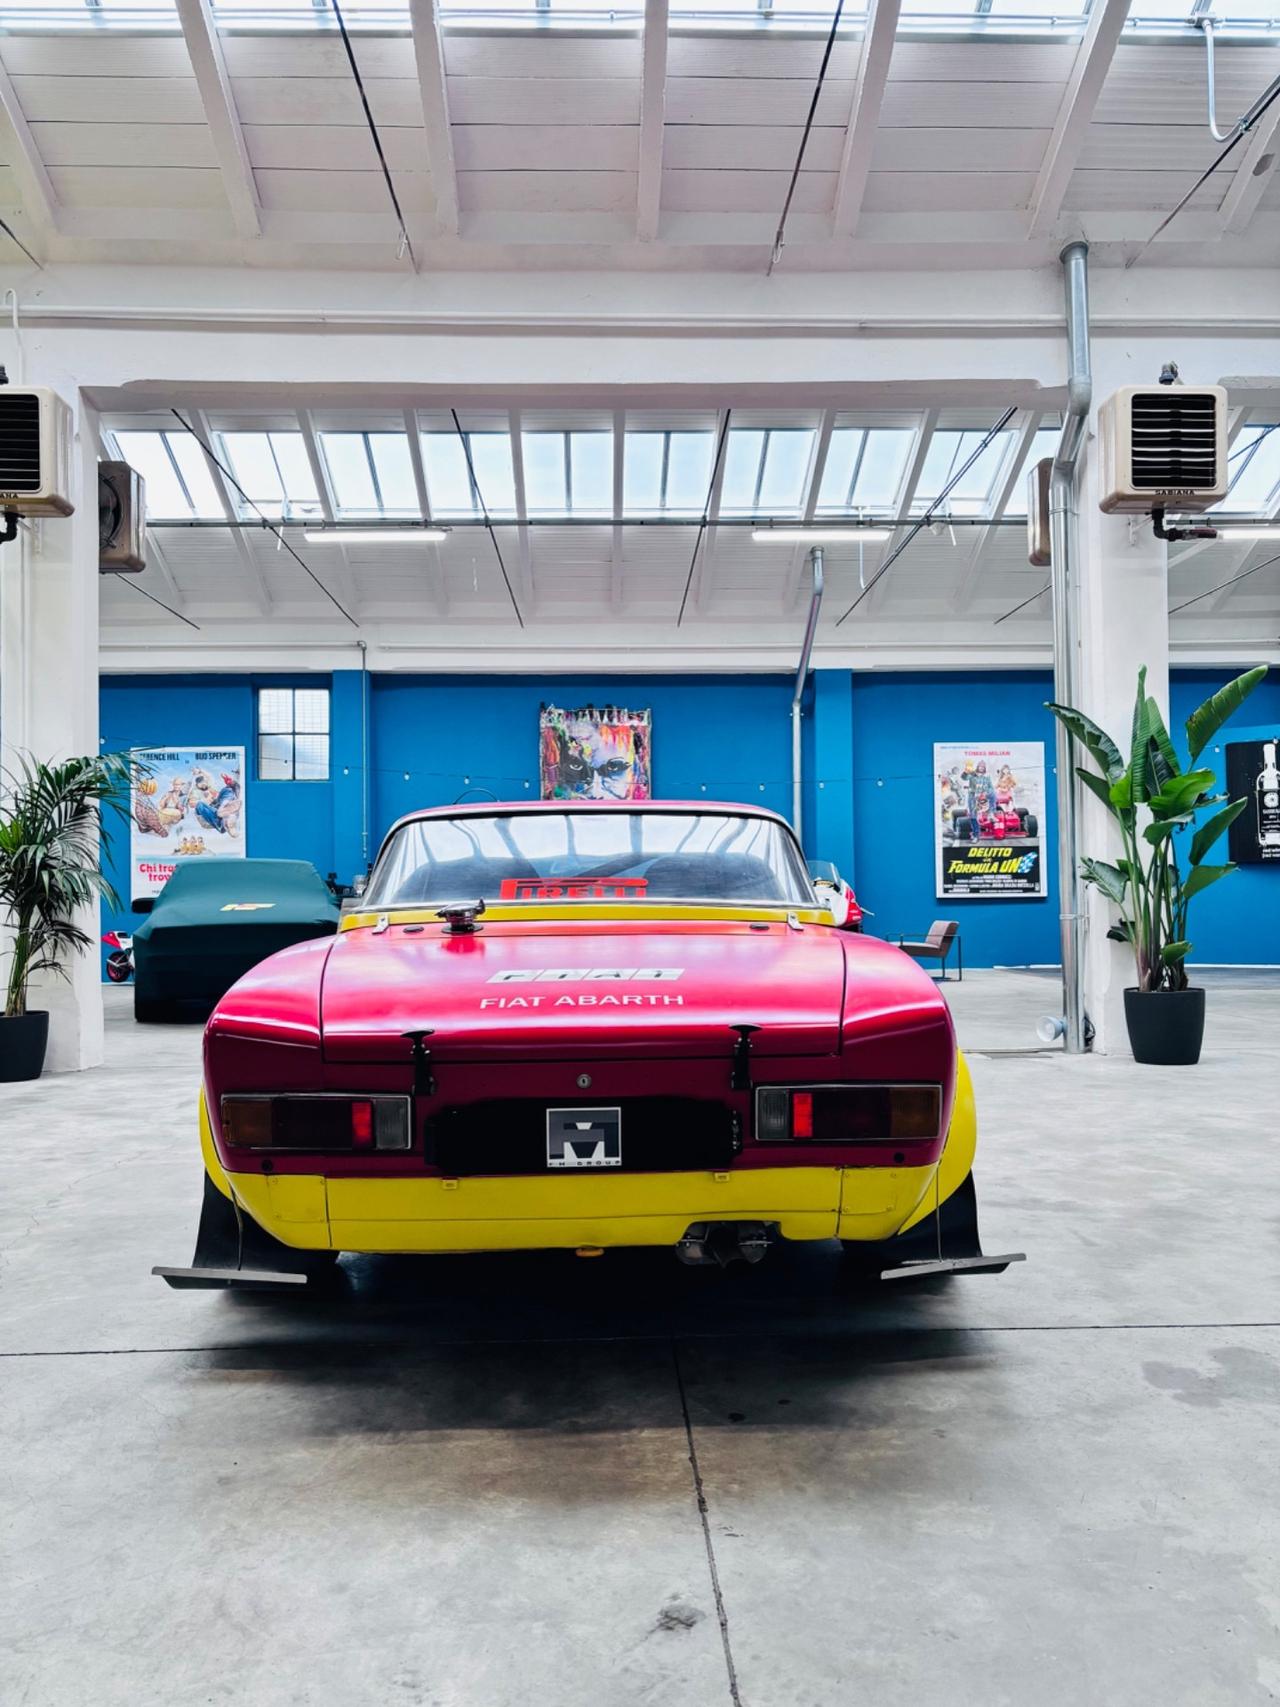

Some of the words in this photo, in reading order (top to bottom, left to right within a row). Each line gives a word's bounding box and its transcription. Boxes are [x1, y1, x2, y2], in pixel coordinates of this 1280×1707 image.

[167, 752, 179, 761] HILL
[968, 847, 1013, 857] DELITTO
[139, 863, 156, 873] Chi
[948, 860, 1000, 873] FORMULA
[499, 877, 649, 899] PIRELLI
[480, 996, 545, 1009] FIAT
[553, 994, 683, 1006] ABARTH
